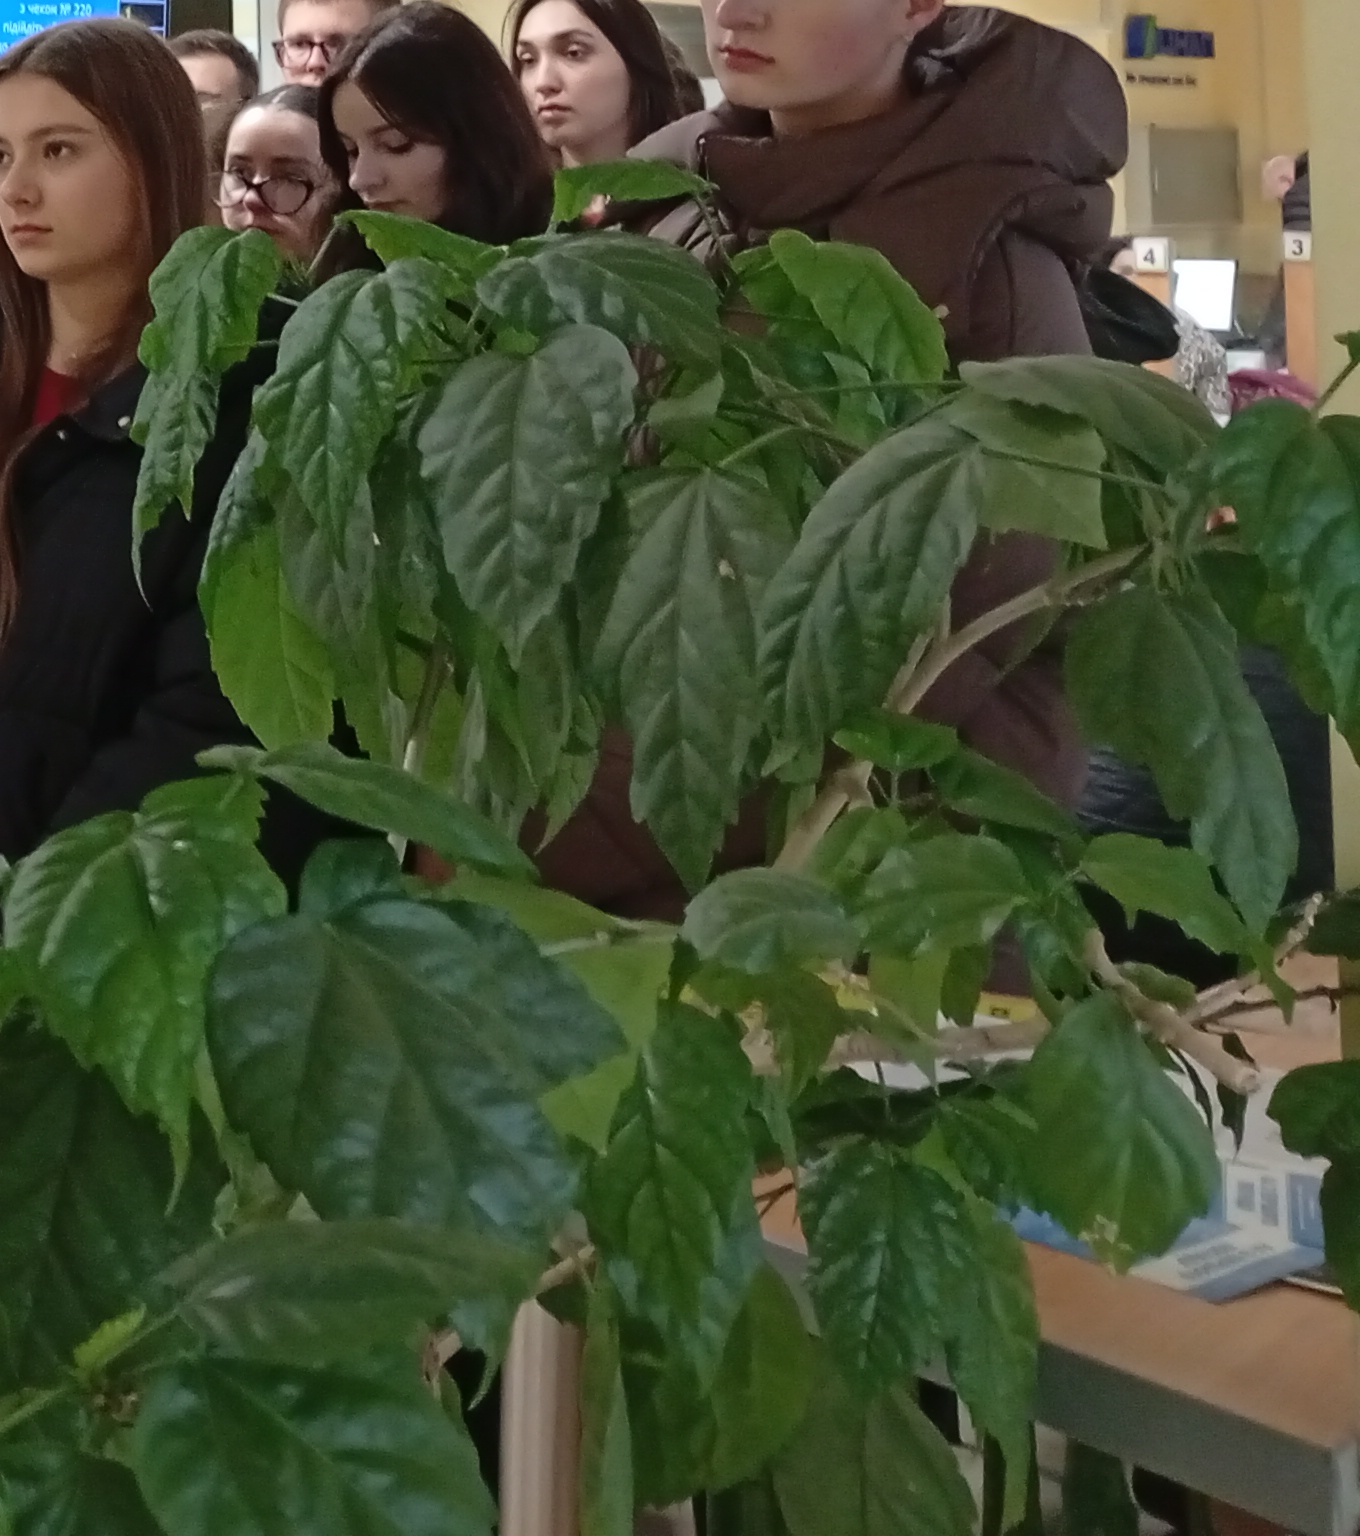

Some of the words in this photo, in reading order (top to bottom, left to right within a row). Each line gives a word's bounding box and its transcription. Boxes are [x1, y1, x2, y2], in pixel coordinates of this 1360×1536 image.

[27, 3, 58, 16] чеком
[73, 3, 93, 17] 220
[1143, 247, 1156, 265] 4
[1291, 238, 1304, 257] 3
